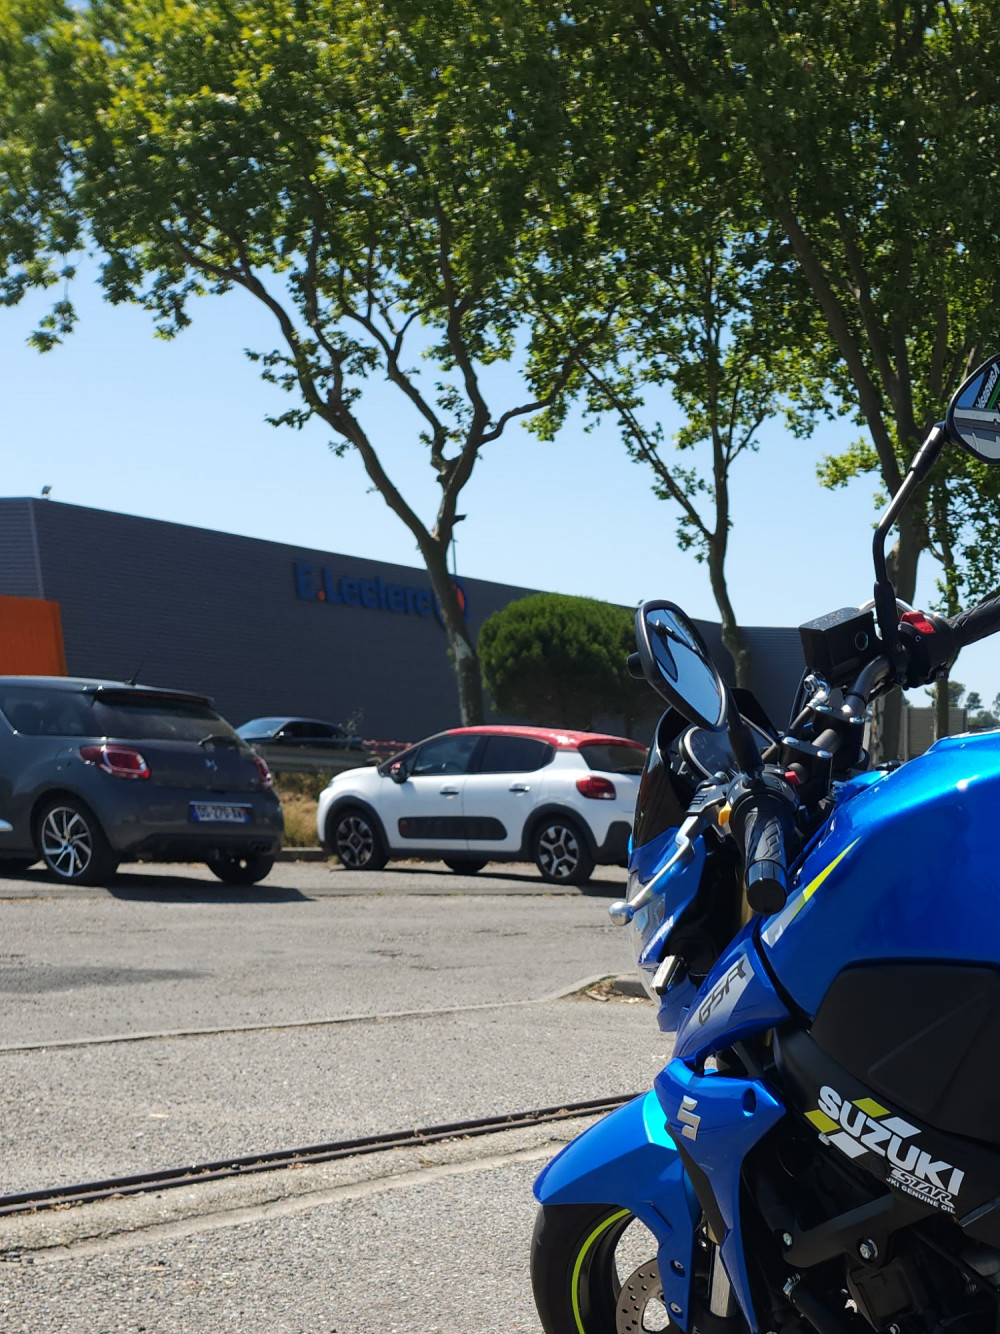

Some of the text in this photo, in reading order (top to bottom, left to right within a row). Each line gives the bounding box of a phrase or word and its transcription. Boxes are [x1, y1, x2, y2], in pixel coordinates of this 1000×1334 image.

[295, 561, 433, 617] E.Leclerc
[698, 958, 747, 1026] GSR
[817, 1085, 965, 1197] SUZUKI
[901, 1185, 940, 1208] GENUINE
[941, 1204, 956, 1215] OIL
